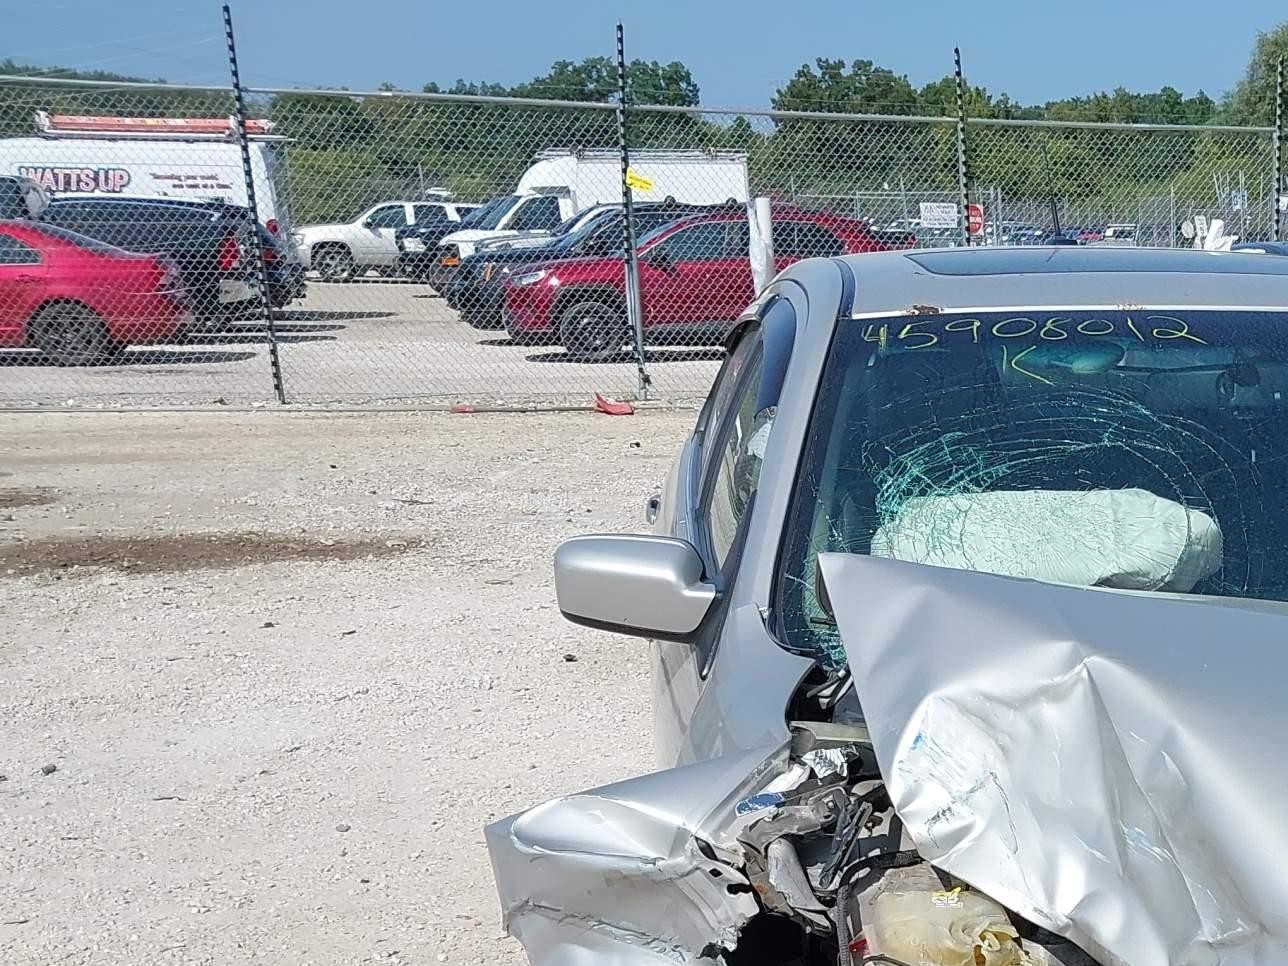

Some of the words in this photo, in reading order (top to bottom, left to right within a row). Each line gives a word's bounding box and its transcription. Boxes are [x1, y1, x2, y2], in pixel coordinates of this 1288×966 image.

[19, 166, 95, 192] WATTS
[98, 167, 130, 192] UP
[861, 316, 1208, 351] 45908012
[1003, 345, 1055, 386] K
